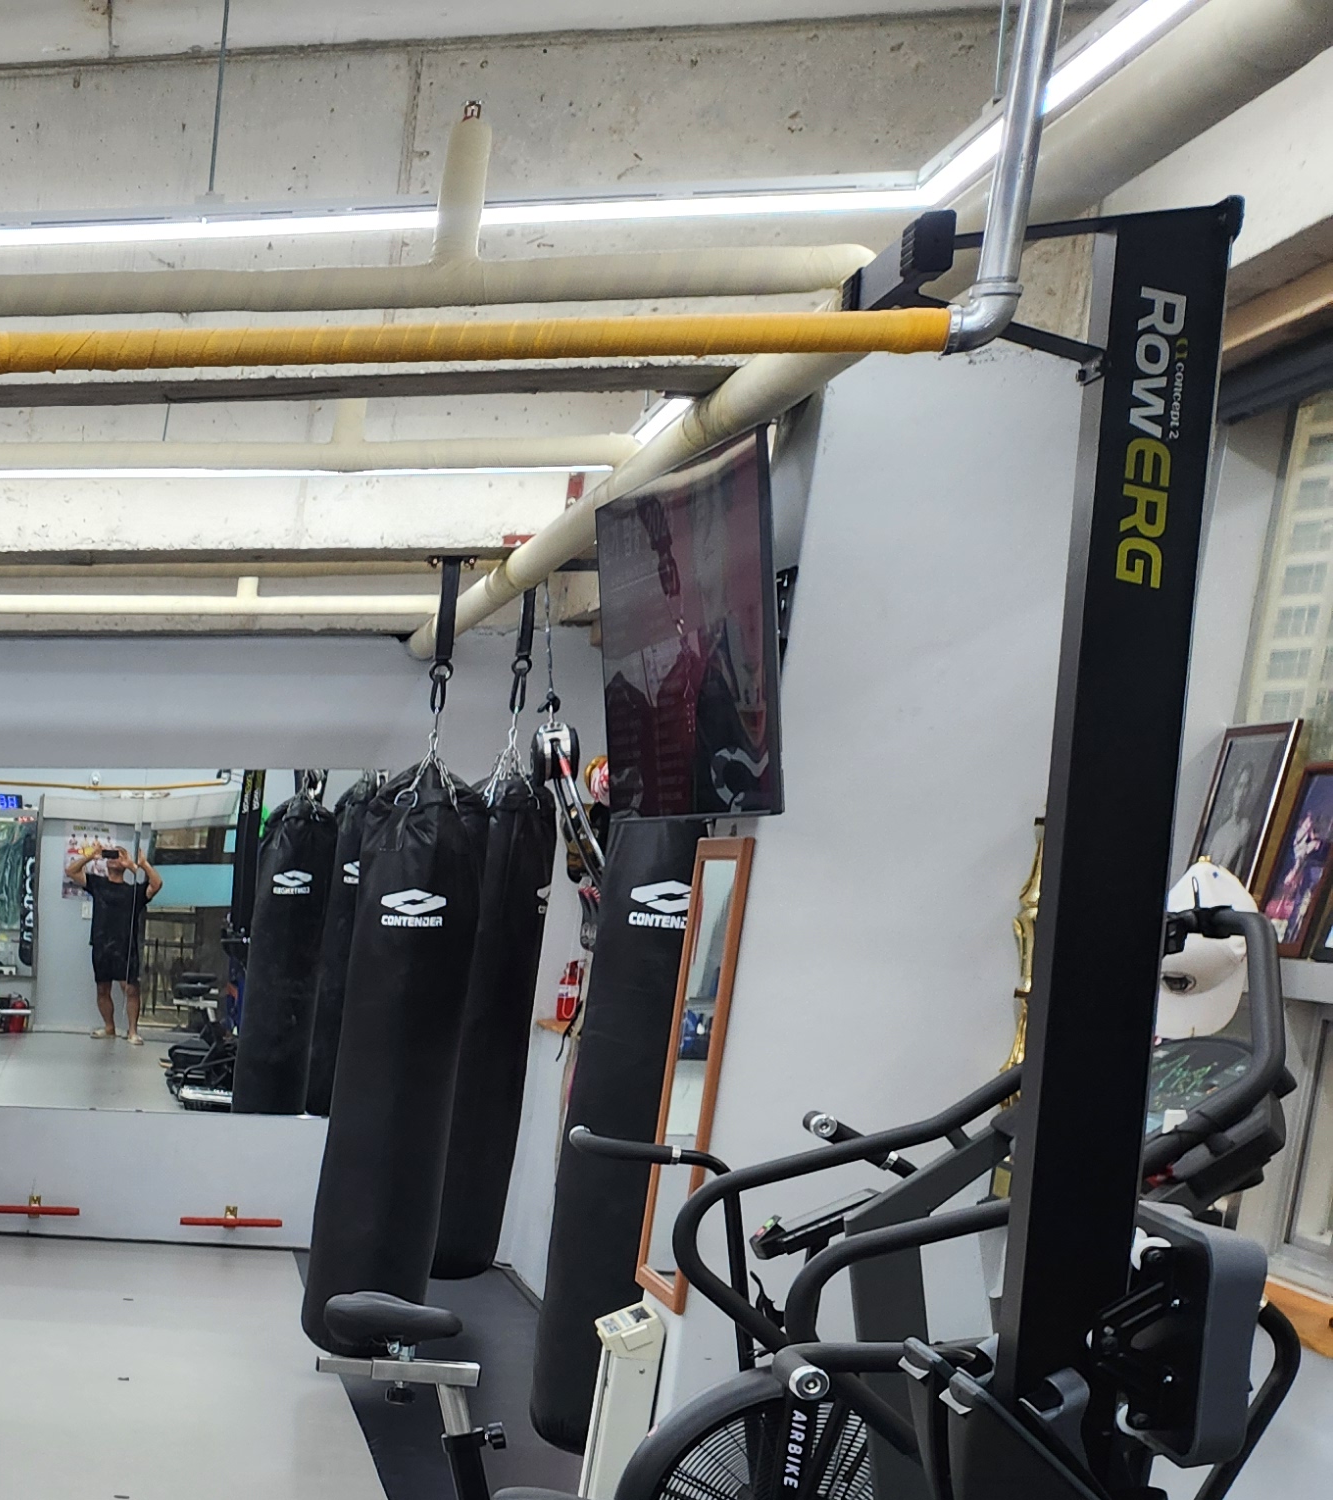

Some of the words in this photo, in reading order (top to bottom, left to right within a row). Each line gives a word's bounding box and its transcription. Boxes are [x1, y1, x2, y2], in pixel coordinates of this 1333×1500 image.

[1170, 362, 1184, 428] concept
[380, 914, 443, 927] CONTENDER
[783, 1409, 808, 1489] AIRBIKE
